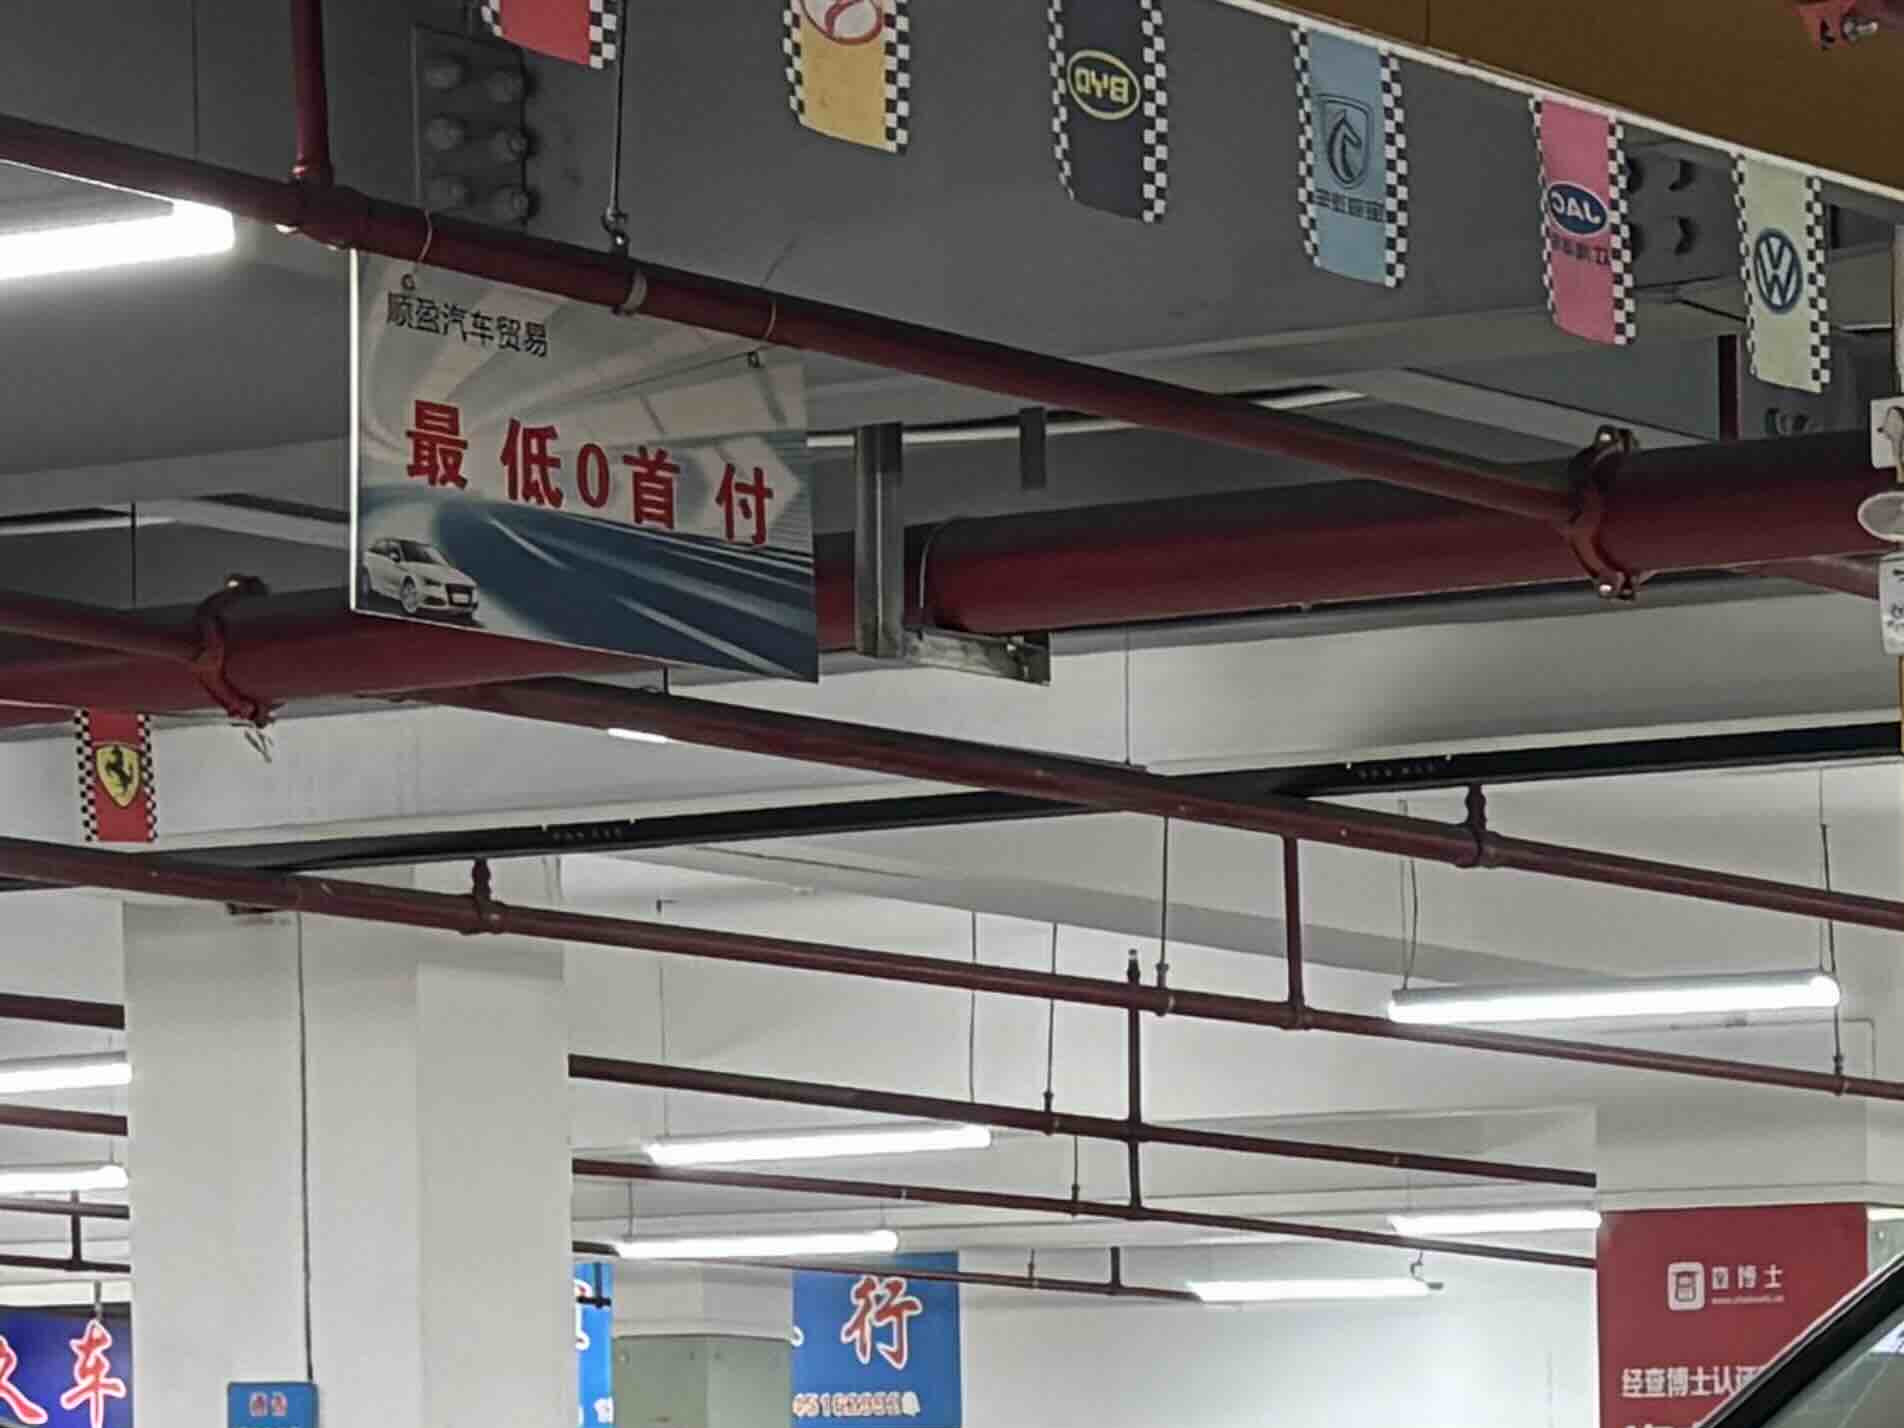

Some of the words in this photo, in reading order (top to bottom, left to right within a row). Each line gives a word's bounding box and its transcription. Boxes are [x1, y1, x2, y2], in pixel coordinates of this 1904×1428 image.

[386, 292, 549, 358] 顺盈汽车贸易
[406, 400, 775, 546] 最低0首付
